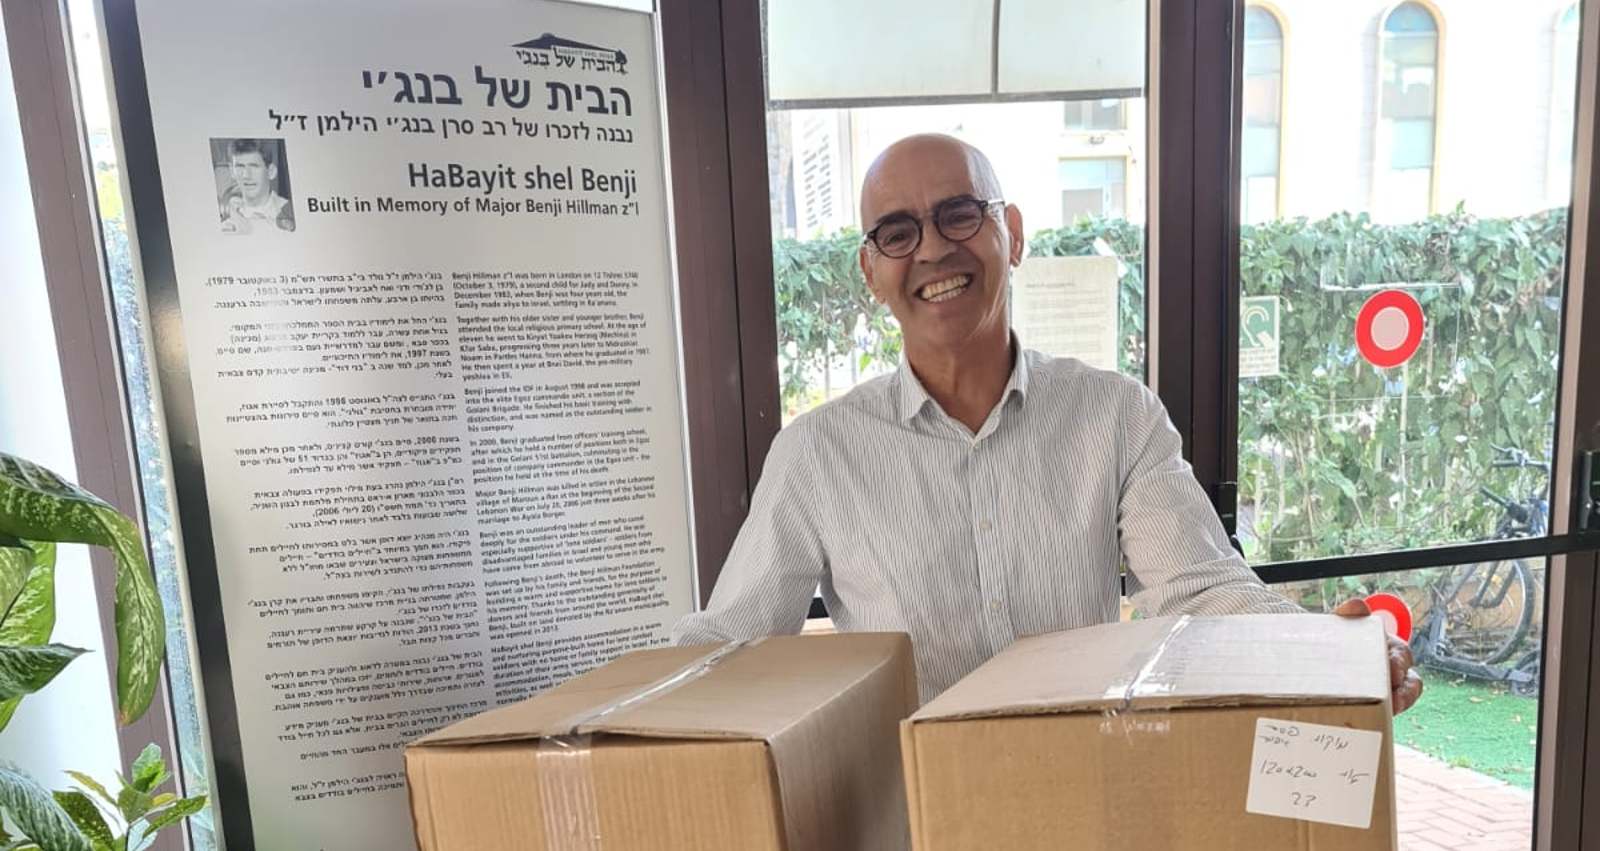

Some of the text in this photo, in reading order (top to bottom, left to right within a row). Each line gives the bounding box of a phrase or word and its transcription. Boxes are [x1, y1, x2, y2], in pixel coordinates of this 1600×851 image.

[474, 65, 532, 109] של
[545, 81, 632, 117] הבית
[316, 110, 378, 137] הילמן
[441, 118, 475, 140] סרן
[481, 120, 507, 136] רב
[511, 116, 539, 138] של
[545, 120, 590, 141] לזכרו
[596, 127, 633, 144] נבנה
[408, 162, 637, 200] HaBayit shel Benji
[307, 196, 350, 213] Built
[354, 196, 372, 213] in
[376, 197, 448, 217] Memory
[453, 196, 471, 213] of
[475, 197, 521, 217] Major
[525, 198, 562, 217] Benji
[566, 199, 618, 215] Hillman
